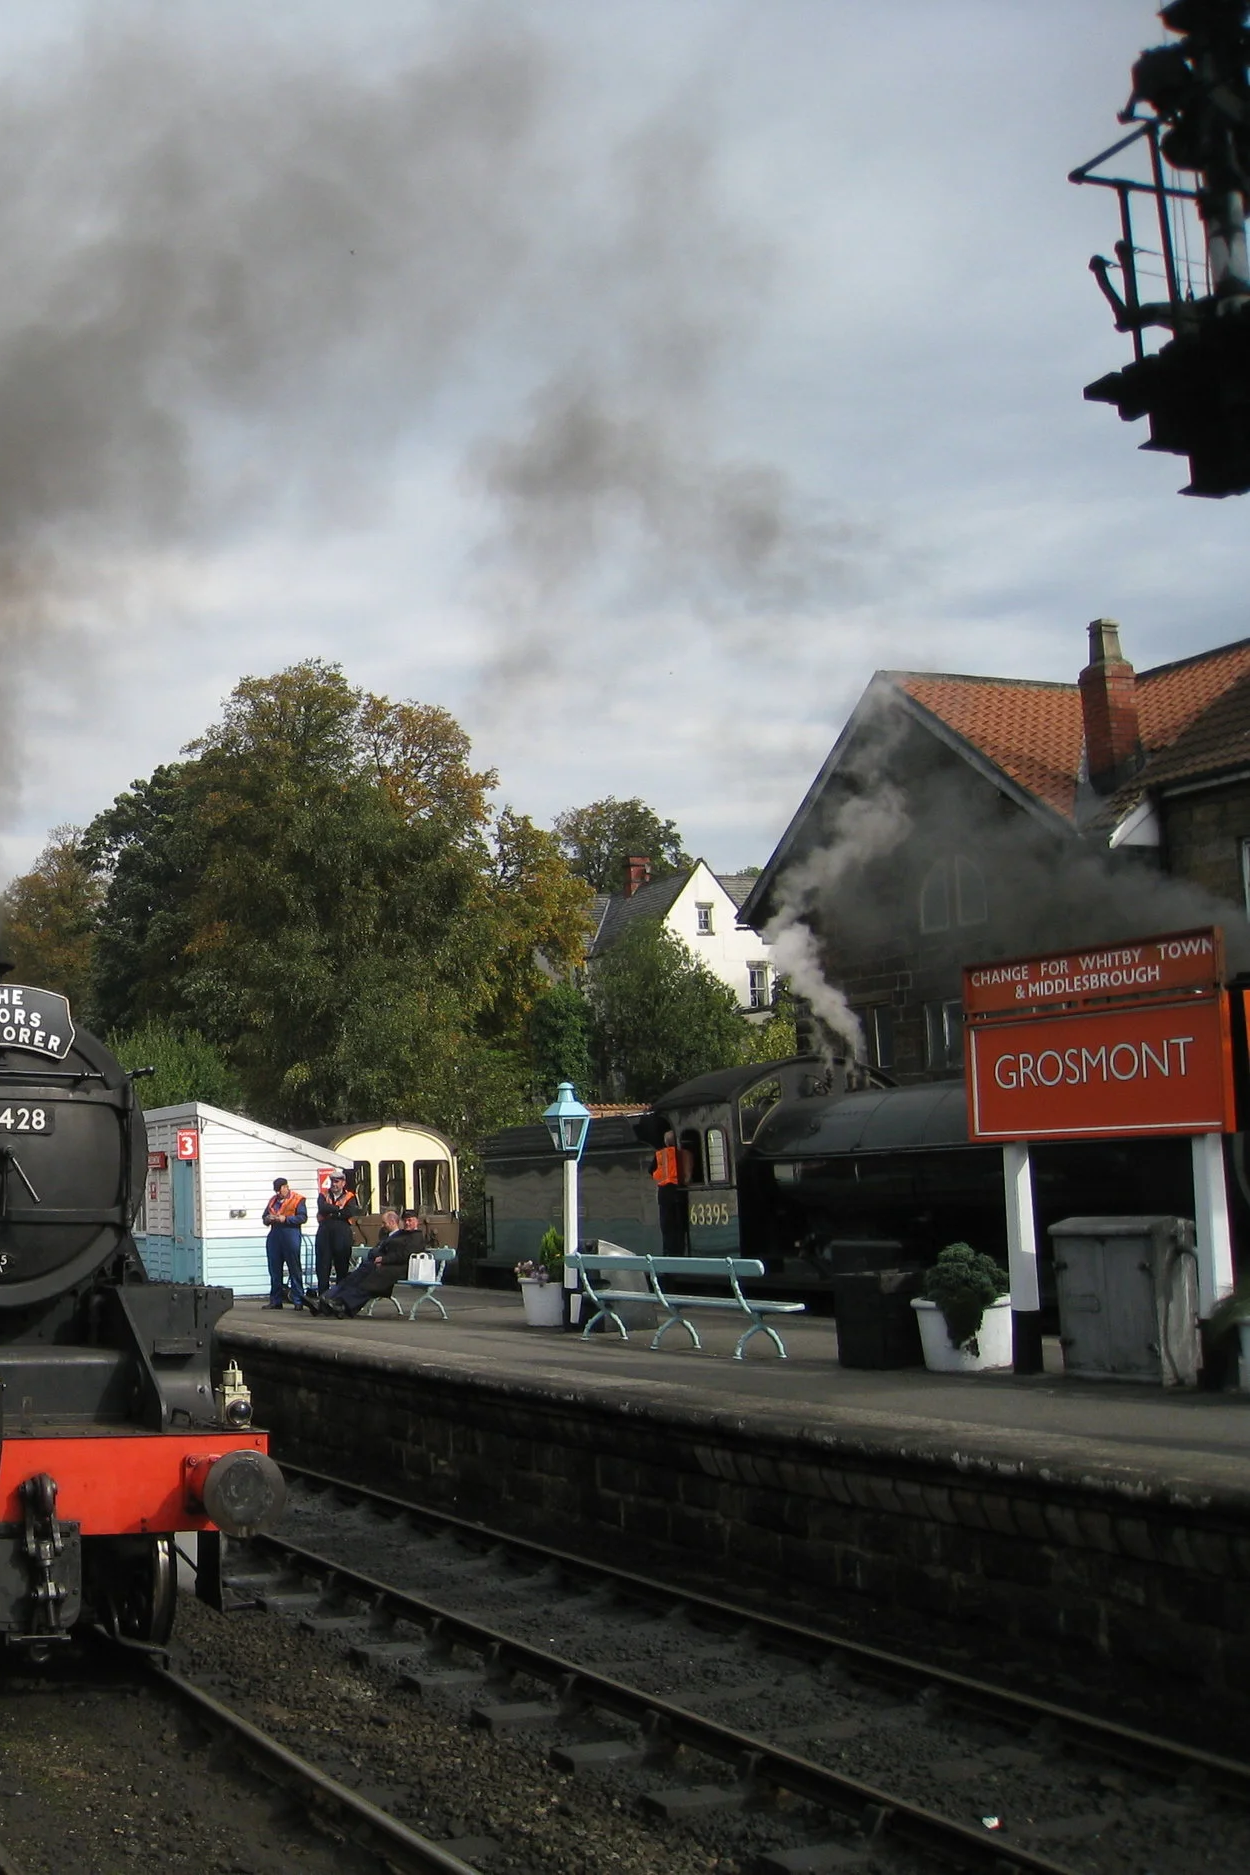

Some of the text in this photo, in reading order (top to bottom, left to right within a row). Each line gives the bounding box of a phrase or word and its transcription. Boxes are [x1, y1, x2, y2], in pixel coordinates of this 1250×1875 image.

[971, 938, 1213, 987] CHANGE FOR WHITBY TOWN
[1015, 965, 1160, 999] & MIDDLESBROUGH
[995, 1037, 1194, 1089] GROSMONT
[181, 1136, 193, 1155] 3
[322, 1175, 332, 1189] 4
[691, 1203, 729, 1225] 63395
